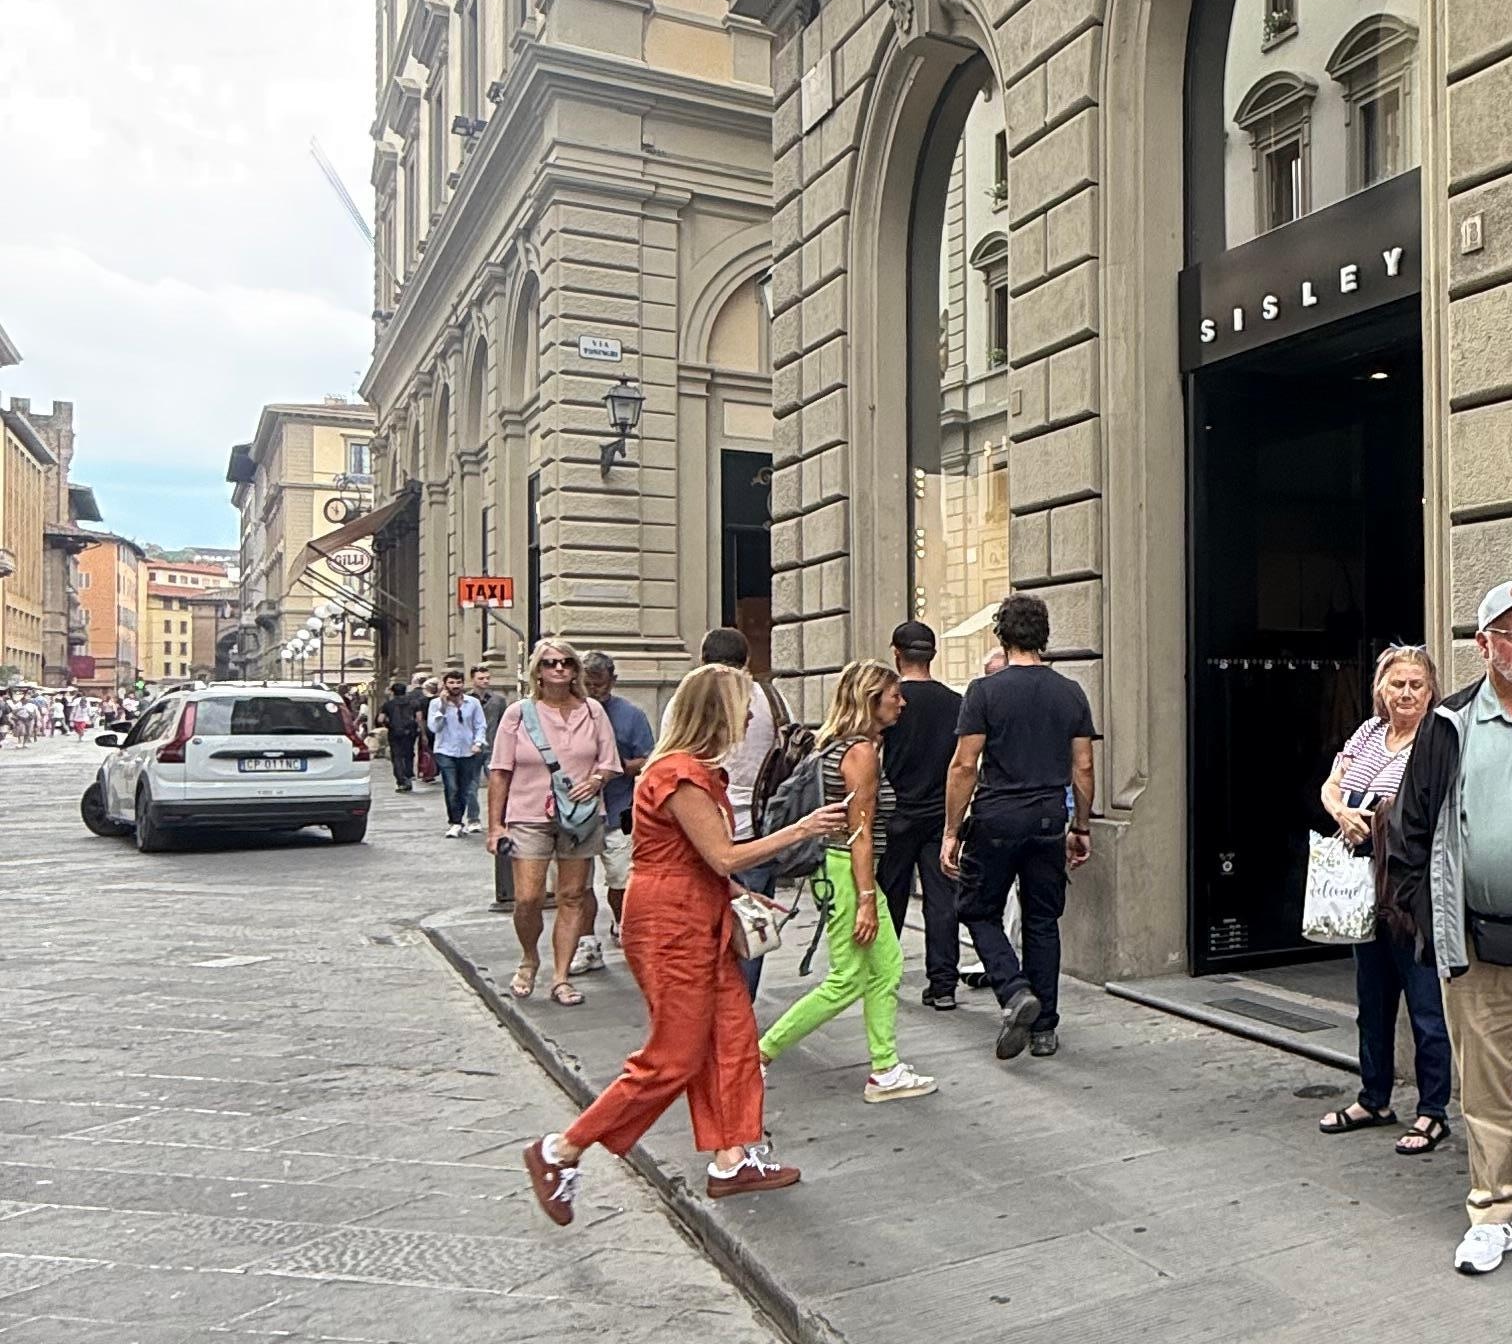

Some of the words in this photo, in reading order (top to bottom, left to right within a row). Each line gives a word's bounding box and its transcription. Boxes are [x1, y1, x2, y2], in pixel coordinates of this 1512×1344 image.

[1200, 247, 1402, 343] SISLEY
[465, 583, 505, 601] TAXI
[1219, 659, 1342, 671] SISLEY
